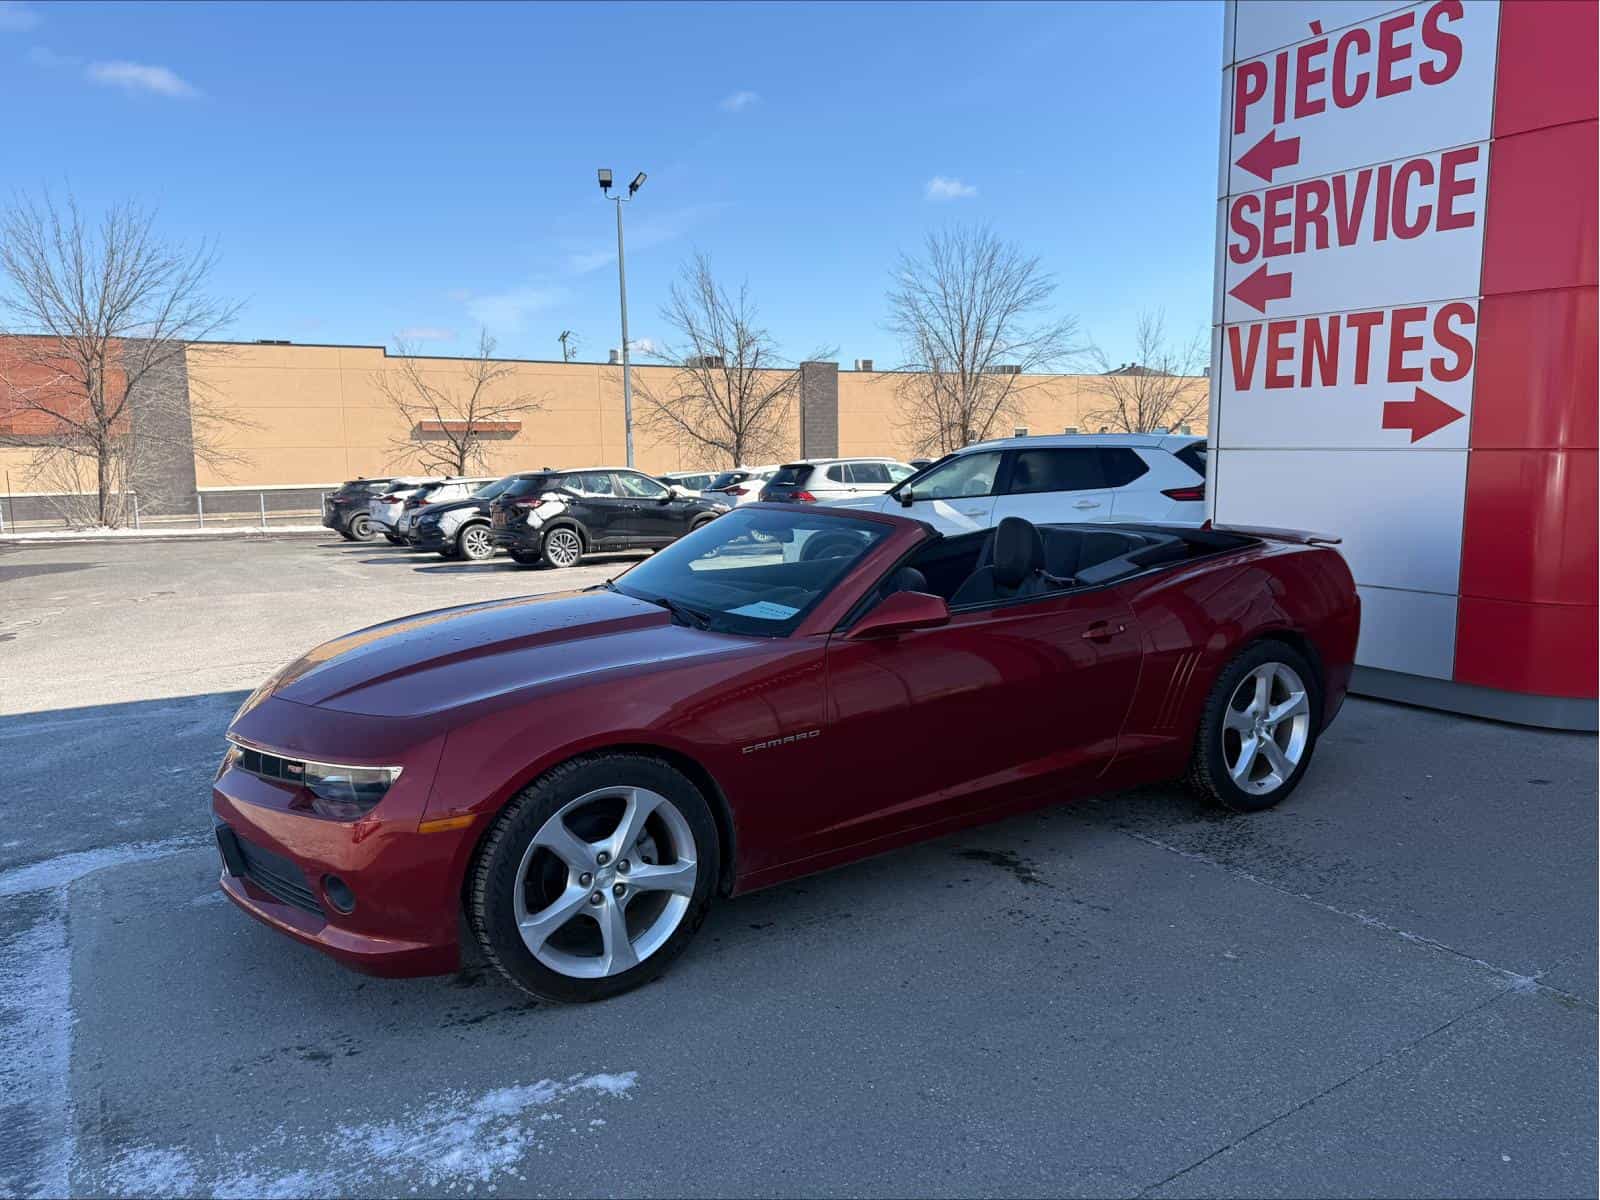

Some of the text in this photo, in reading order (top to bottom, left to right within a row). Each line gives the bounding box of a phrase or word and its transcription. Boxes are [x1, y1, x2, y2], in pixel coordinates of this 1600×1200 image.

[1233, 0, 1465, 134] PIÈCES
[1228, 146, 1480, 264] SERVICE
[1228, 302, 1476, 391] VENTES
[741, 729, 821, 754] CAMARO
